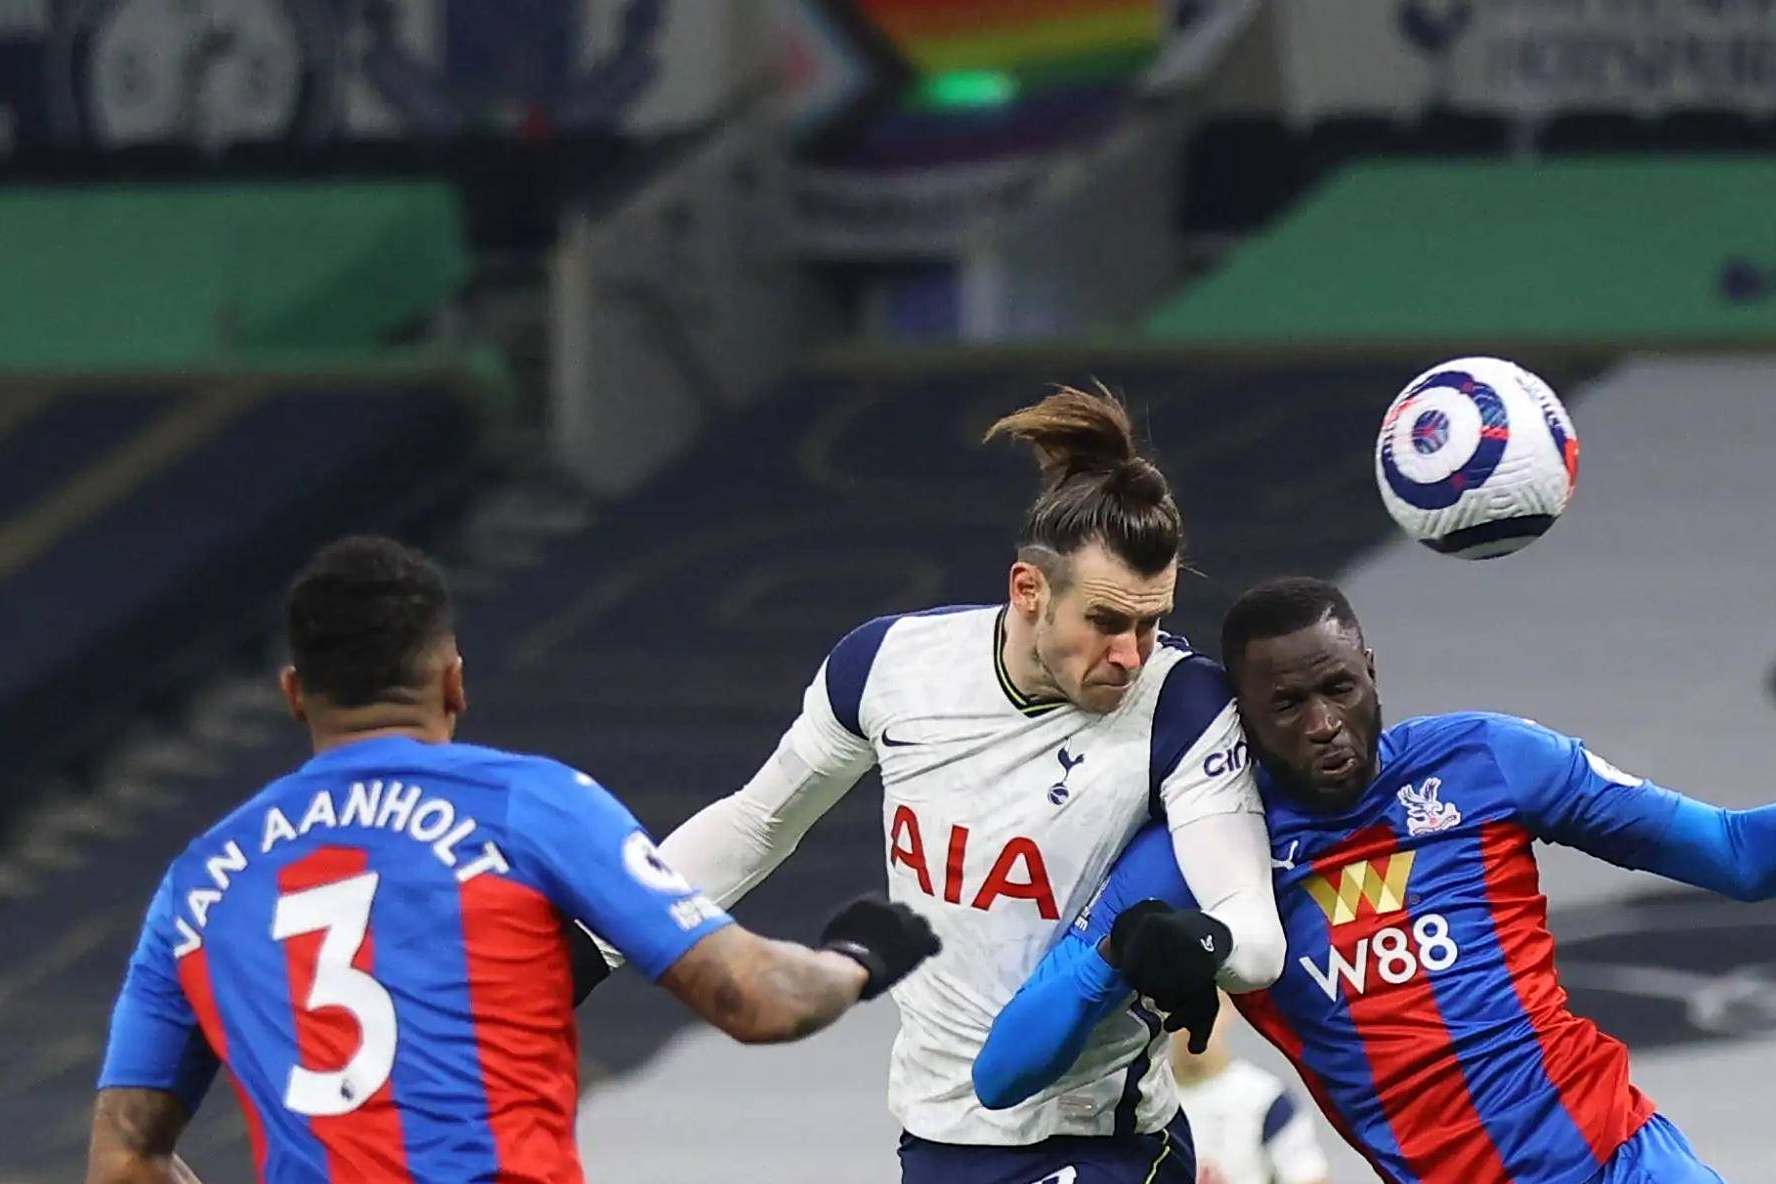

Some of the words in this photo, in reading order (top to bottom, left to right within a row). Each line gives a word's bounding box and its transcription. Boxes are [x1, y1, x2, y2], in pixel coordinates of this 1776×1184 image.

[1203, 741, 1248, 777] cin
[173, 841, 249, 960] VAN
[261, 780, 511, 882] AANHOLT
[889, 804, 1060, 921] AIA
[272, 871, 399, 1117] 3
[1299, 914, 1459, 1002] W88
